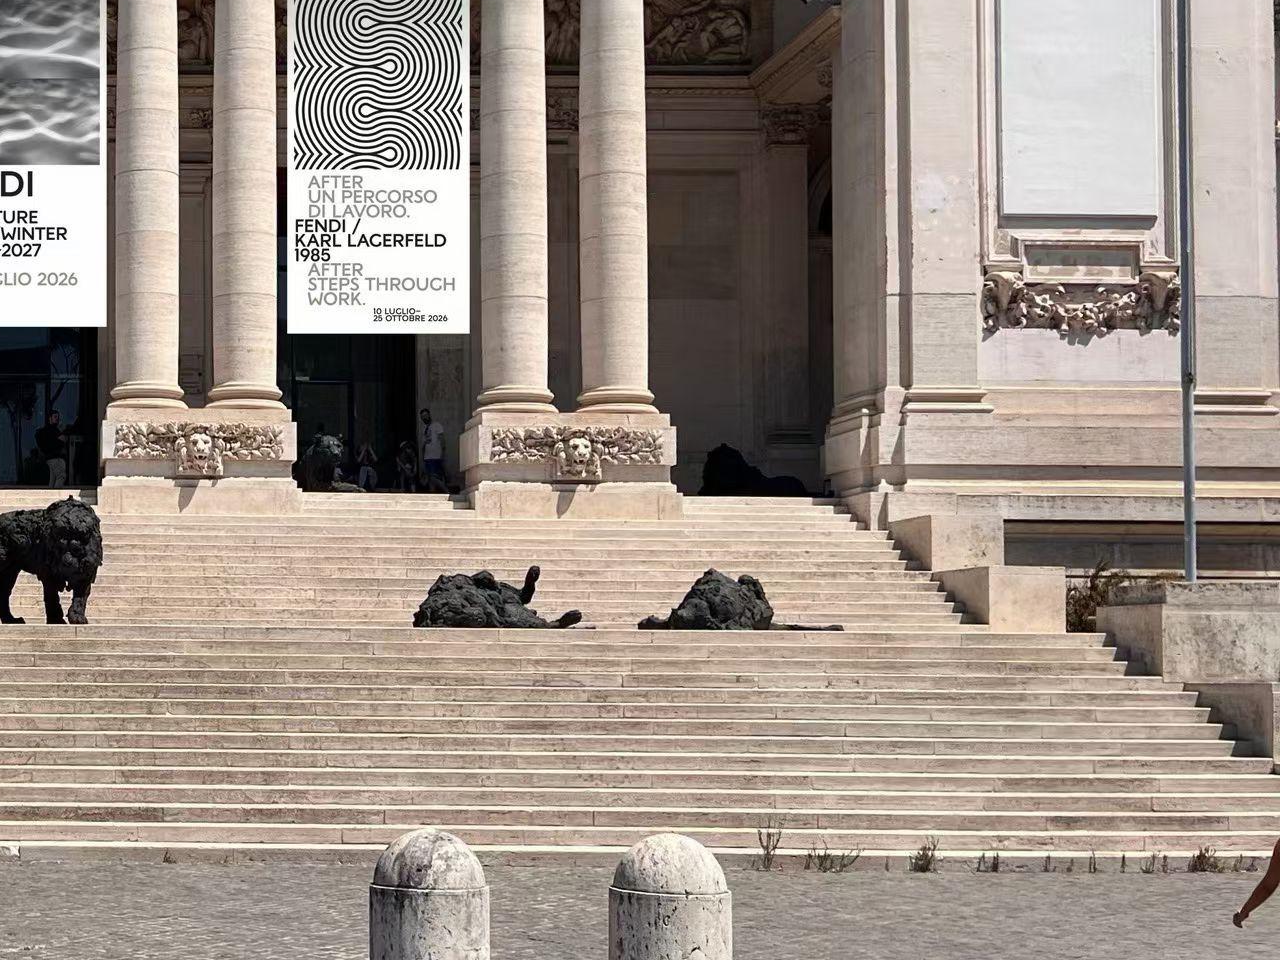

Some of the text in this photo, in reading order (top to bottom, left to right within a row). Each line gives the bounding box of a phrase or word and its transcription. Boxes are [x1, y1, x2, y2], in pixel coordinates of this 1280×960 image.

[308, 175, 363, 189] AFTER
[308, 190, 438, 203] UN PERCORSO
[308, 205, 410, 218] DI LAVORO.
[295, 219, 346, 232] FENDI
[295, 234, 447, 247] KARL LAGERFELD
[295, 248, 331, 262] 1985
[308, 263, 363, 276] AFTER
[37, 272, 78, 286] 2026
[308, 277, 455, 291] STEPS THROUGH
[308, 292, 366, 306] WORK.
